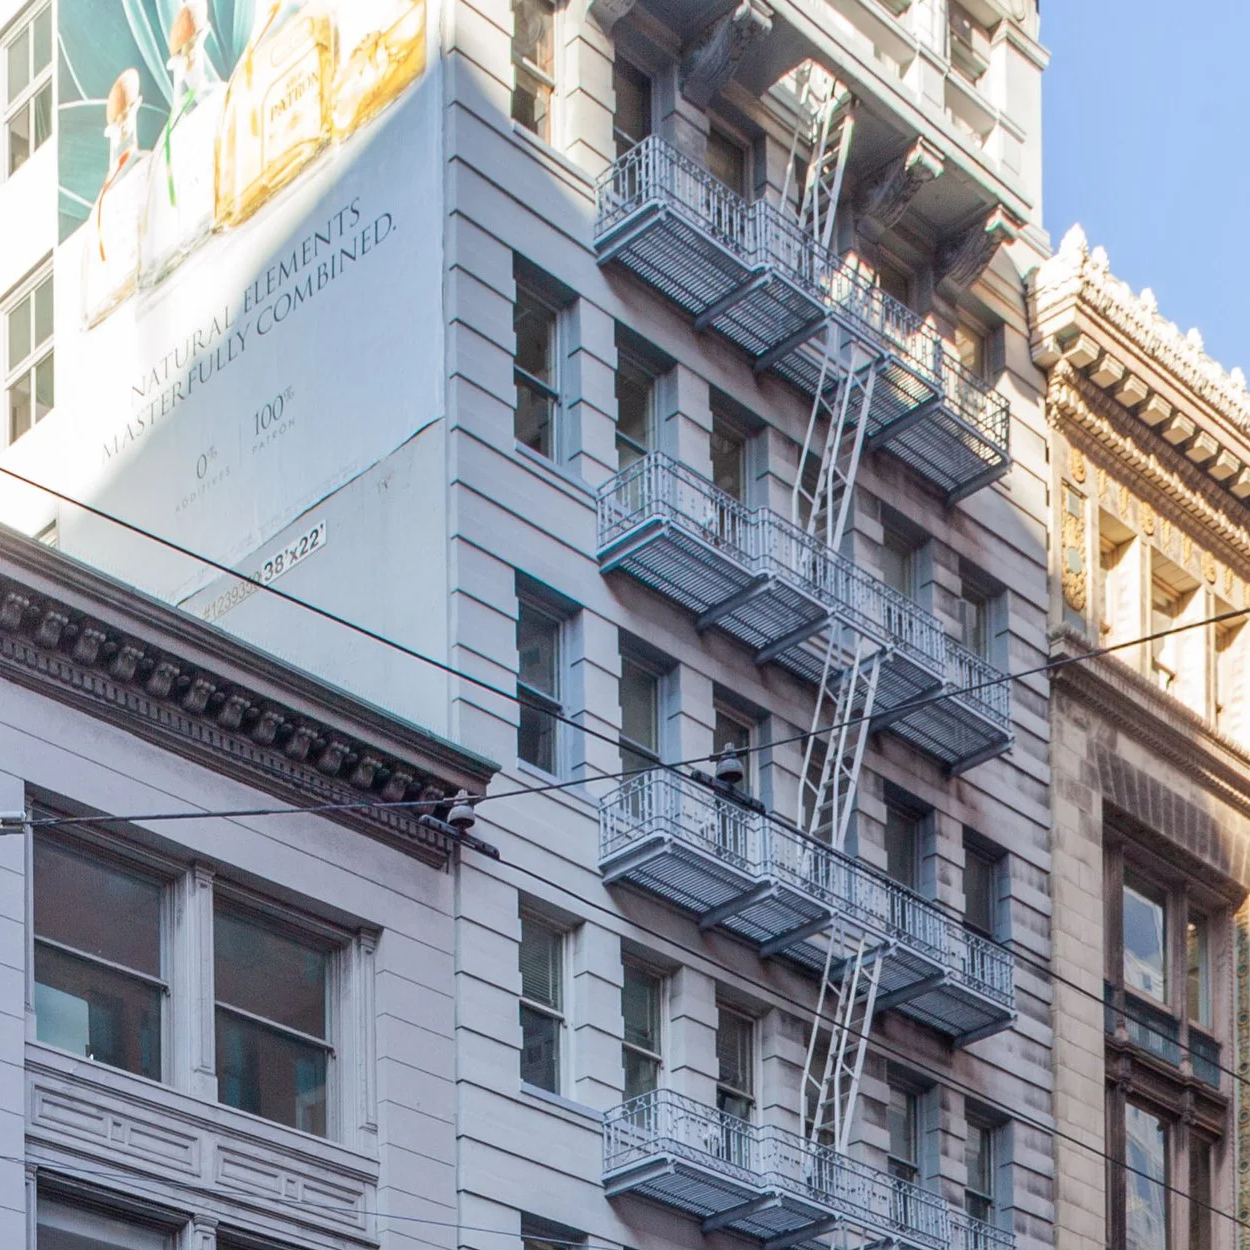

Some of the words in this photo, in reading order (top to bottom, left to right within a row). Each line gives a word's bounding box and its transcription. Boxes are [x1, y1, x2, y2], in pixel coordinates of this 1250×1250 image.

[100, 322, 250, 465] MASTERFULLY
[257, 213, 398, 336] COMBINED.
[131, 306, 234, 402] NATURAL
[243, 197, 362, 314] ELEMENTS
[196, 445, 217, 480] 0%
[255, 384, 295, 435] 100%
